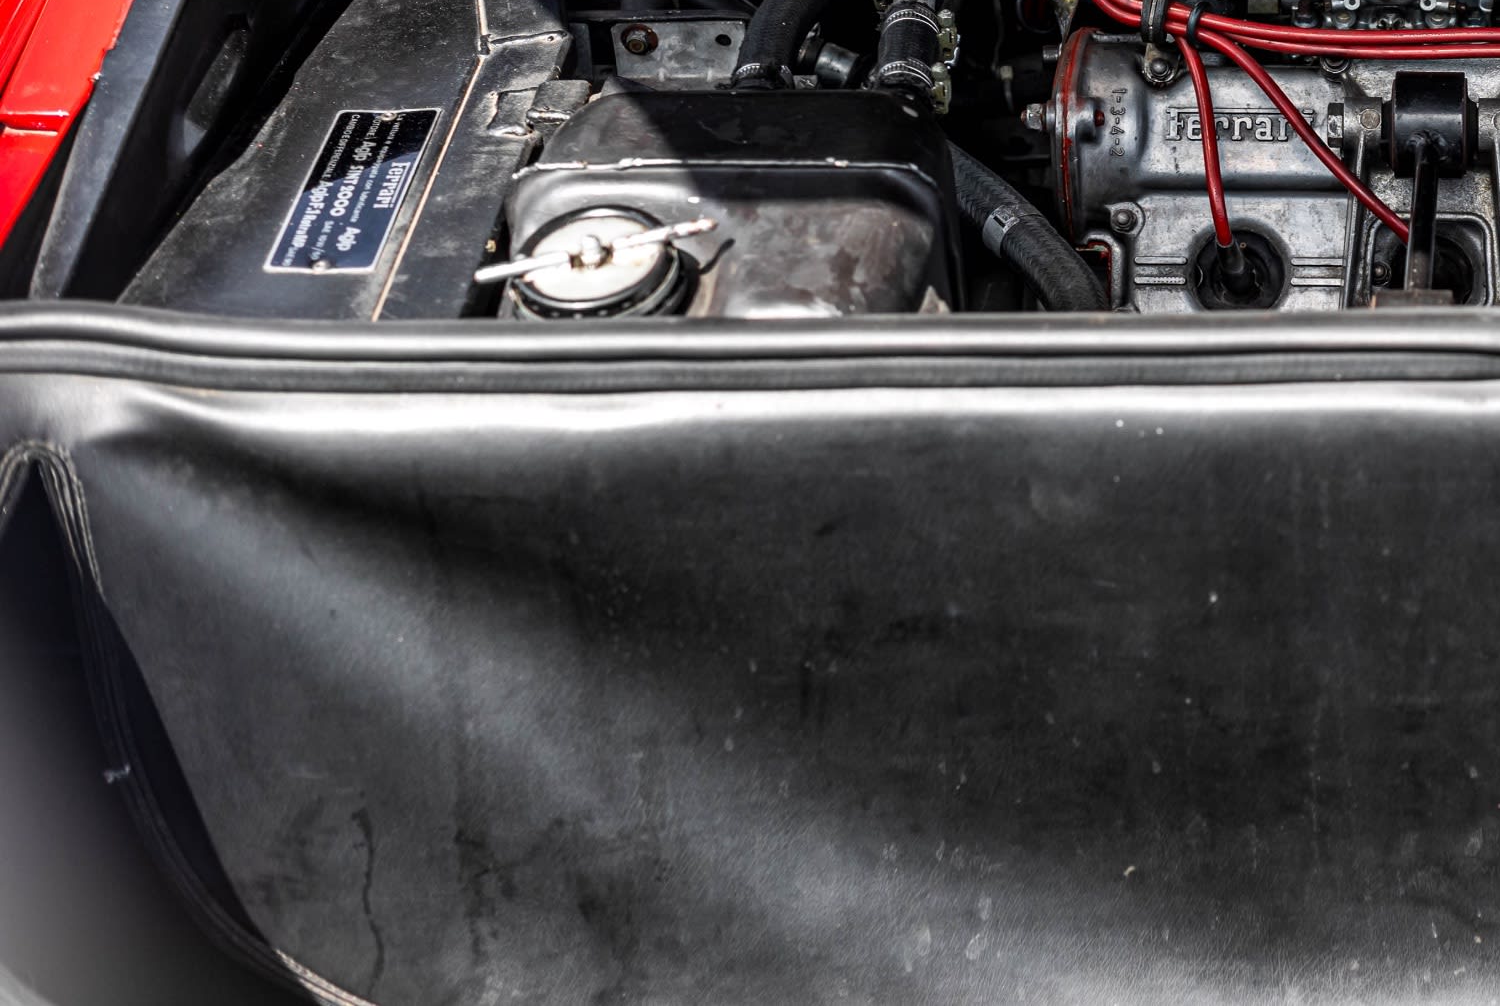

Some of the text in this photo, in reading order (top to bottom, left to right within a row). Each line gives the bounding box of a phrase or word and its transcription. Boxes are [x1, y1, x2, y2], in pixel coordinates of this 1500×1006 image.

[1109, 88, 1126, 157] 1-3-4-2
[350, 141, 377, 160] Agip
[342, 165, 364, 184] SINT
[372, 161, 411, 208] Ferrari
[306, 181, 334, 201] Agip
[327, 186, 355, 216] 2000
[333, 226, 362, 251] Agip
